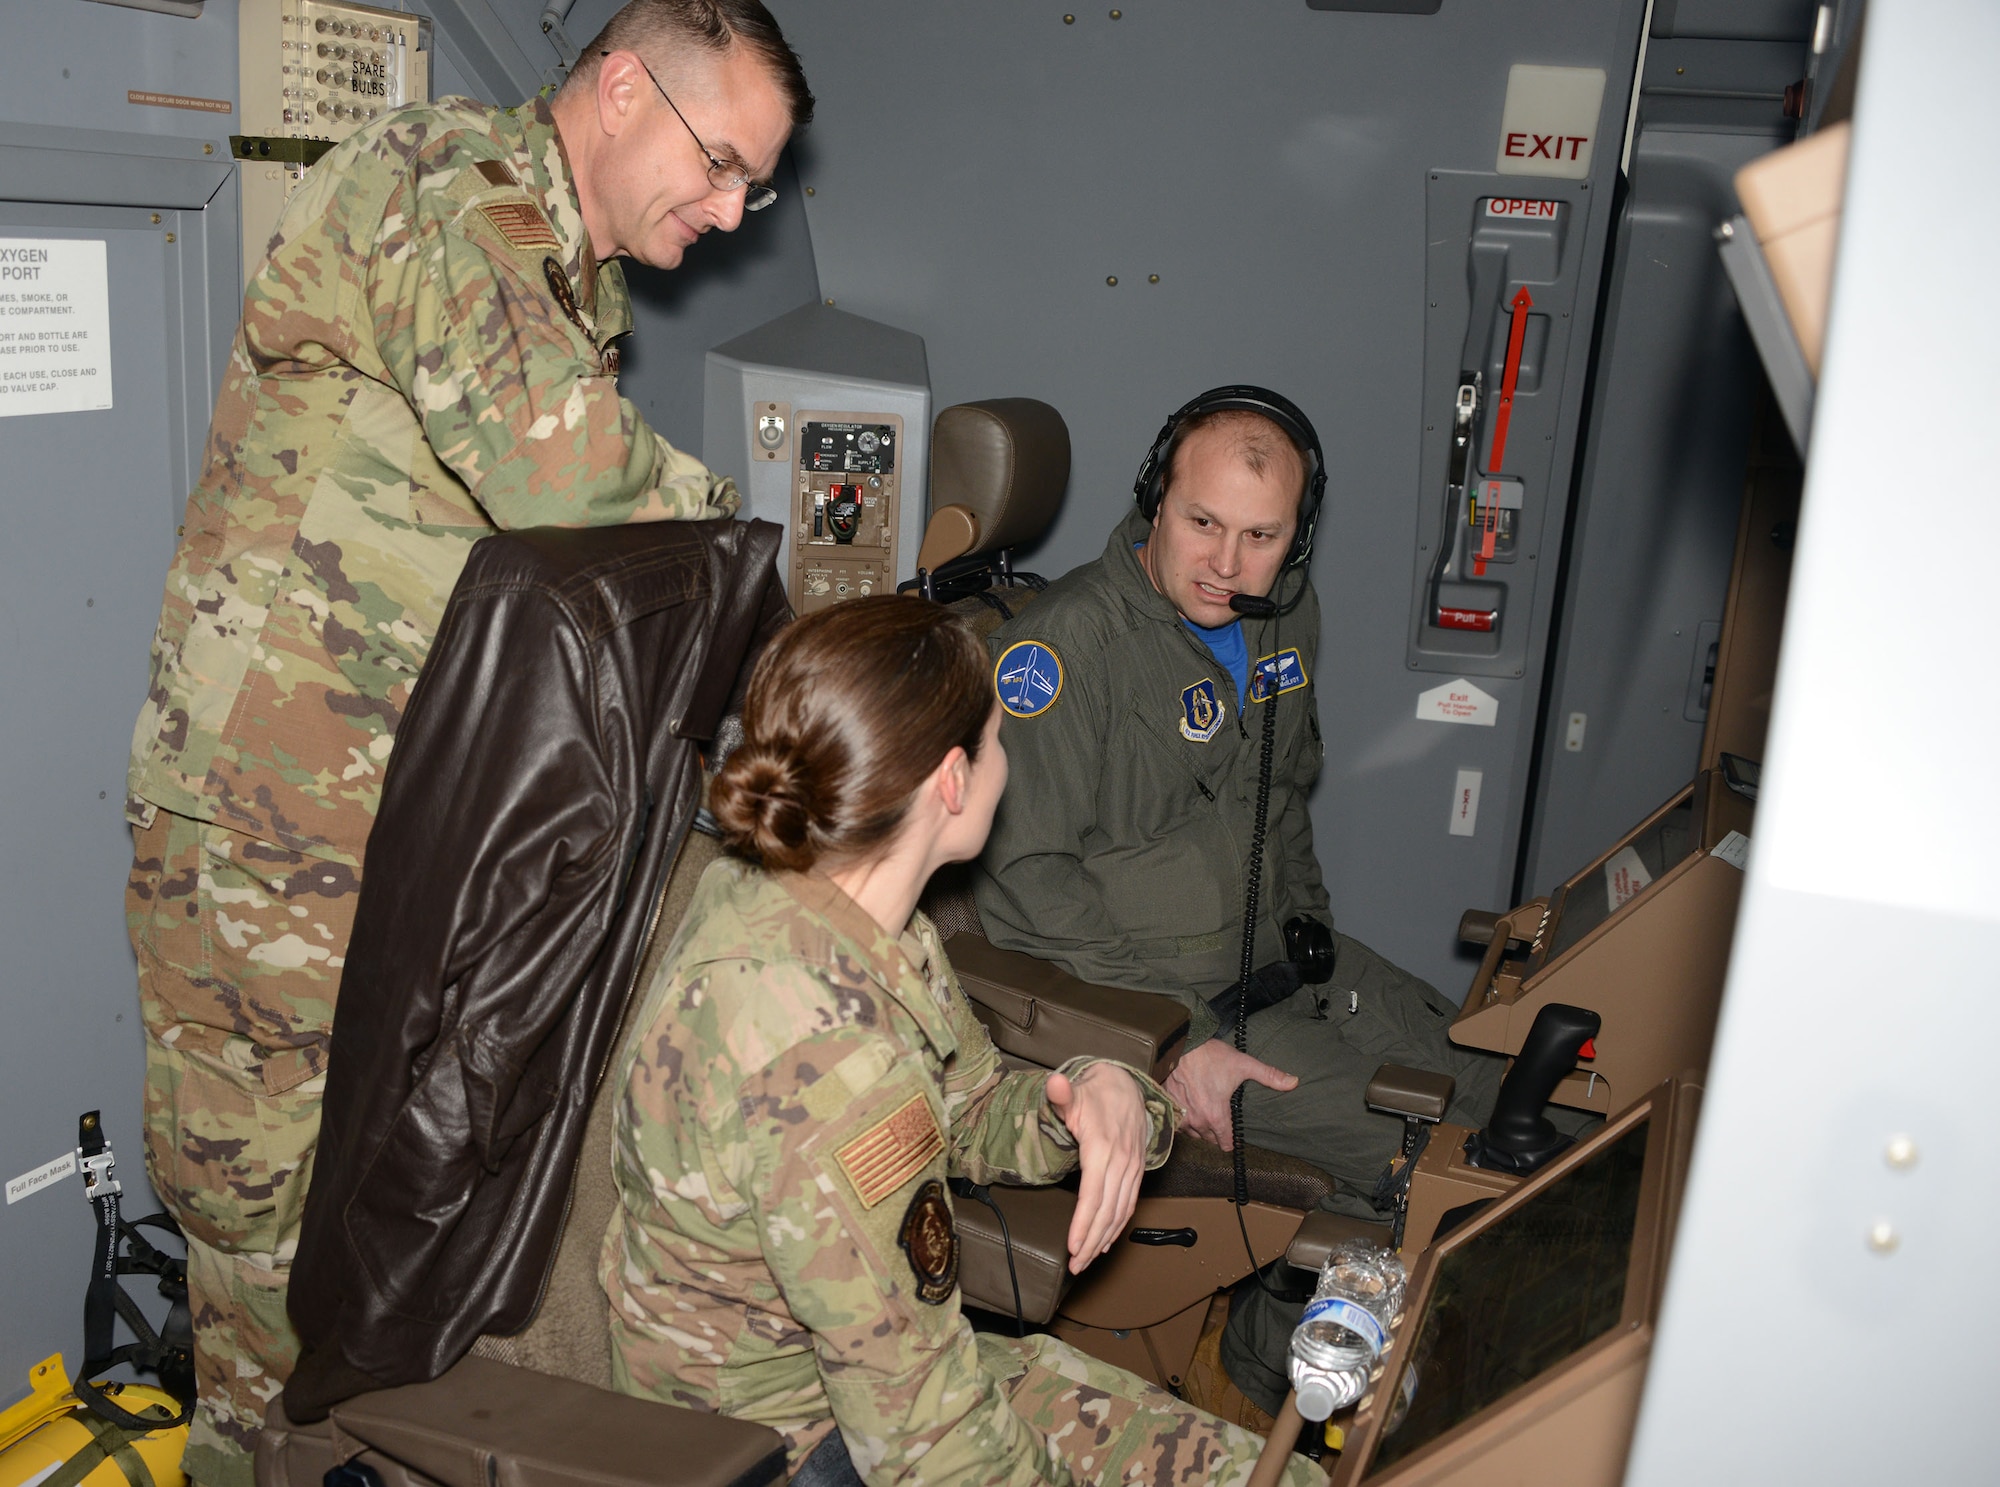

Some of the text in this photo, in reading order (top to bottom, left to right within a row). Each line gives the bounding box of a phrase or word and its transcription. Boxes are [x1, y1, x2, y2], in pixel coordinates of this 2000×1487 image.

[352, 60, 385, 78] SPARE
[352, 80, 385, 96] BULBS
[129, 93, 145, 101] CLOSE
[157, 96, 175, 104] SECURE
[175, 98, 190, 106] DOOR
[1505, 133, 1588, 161] EXIT
[1490, 198, 1555, 217] OPEN
[2, 266, 41, 280] PORT
[21, 293, 54, 303] SMOKE,
[55, 293, 68, 302] OR
[8, 306, 75, 316] COMPARTMENT.
[18, 332, 36, 341] AND
[38, 331, 70, 340] BOTTLE
[72, 331, 88, 339] ARE
[19, 345, 46, 354] PRIOR
[48, 344, 59, 352] TO
[61, 343, 80, 352] USE.
[3, 367, 97, 381] EACH USE, CLOSE AND
[10, 383, 37, 393] VALVE
[39, 382, 59, 391] CAP.
[1455, 612, 1476, 623] Pull
[1450, 693, 1468, 702] Exit
[1453, 703, 1477, 711] Handle
[11, 1161, 72, 1195] Full Face Mask
